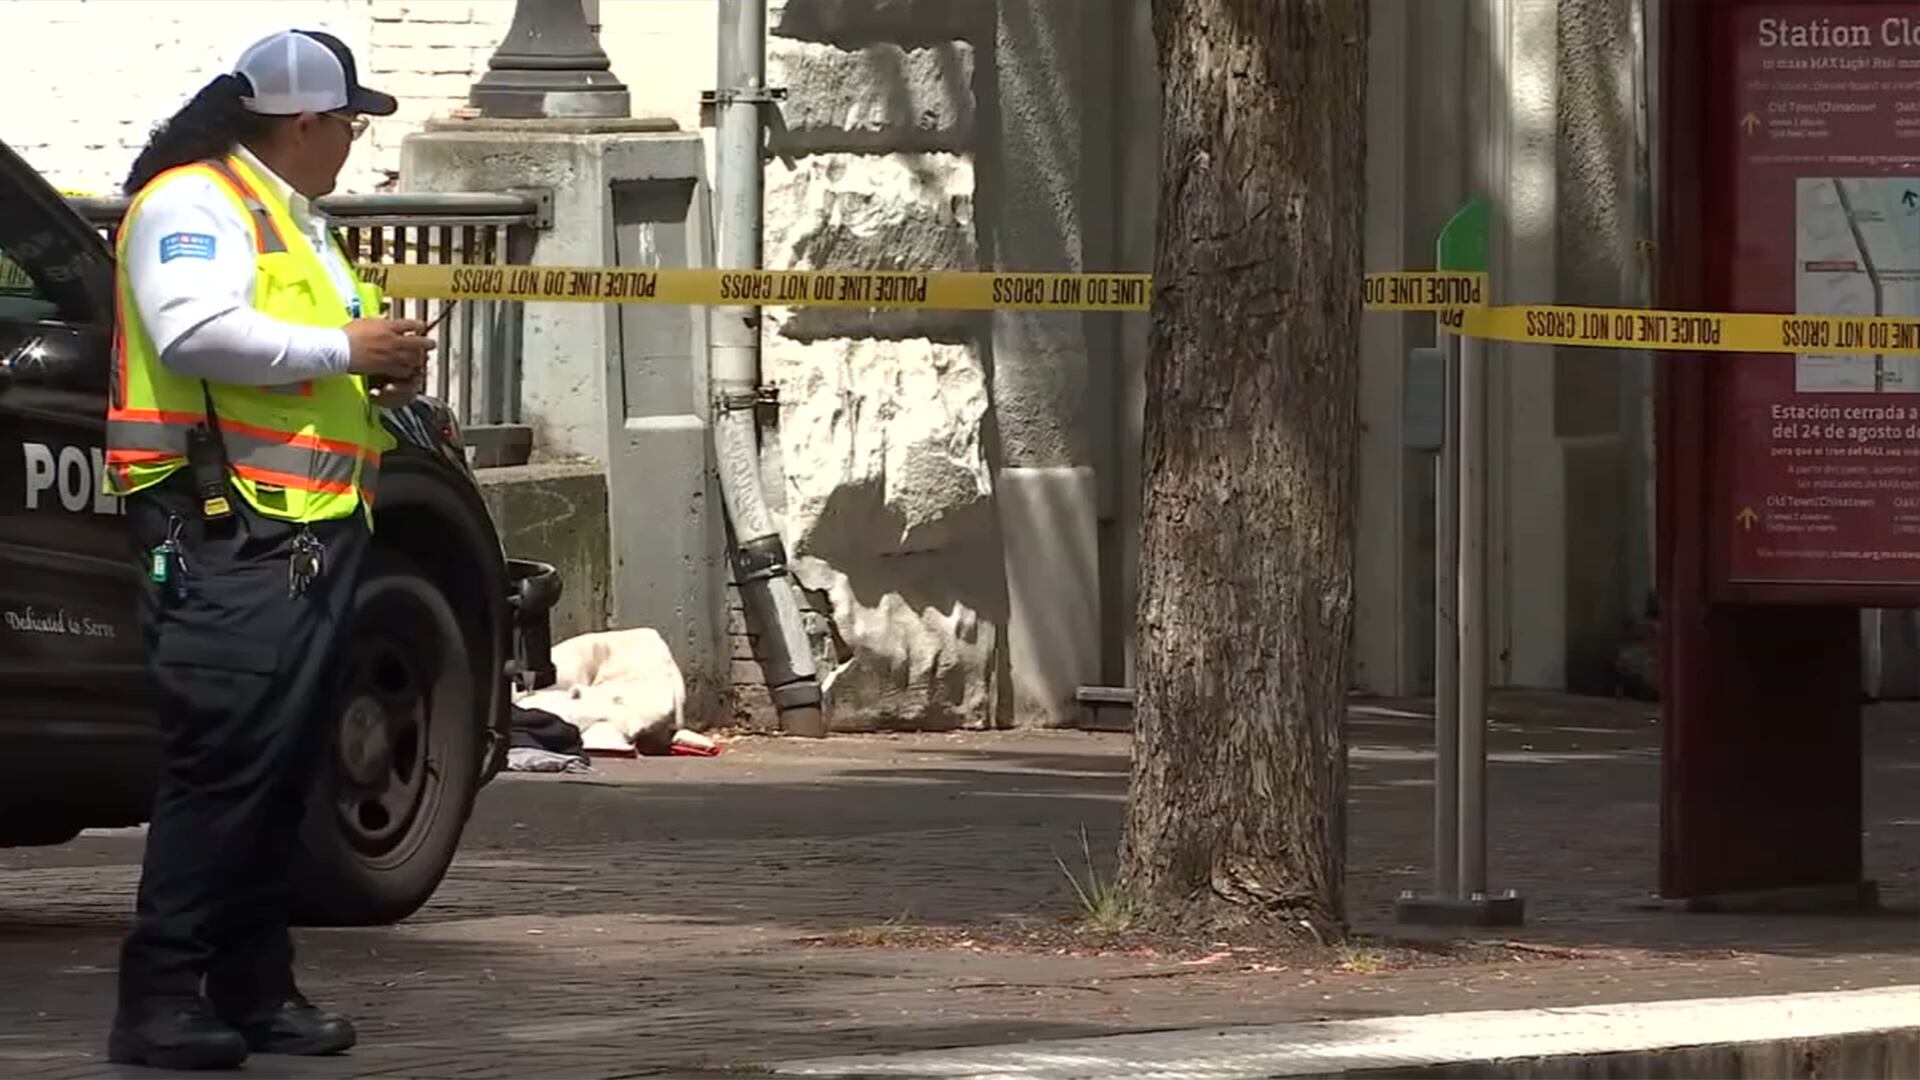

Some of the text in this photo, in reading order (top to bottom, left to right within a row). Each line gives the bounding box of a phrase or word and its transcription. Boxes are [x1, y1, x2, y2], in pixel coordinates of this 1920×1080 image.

[1759, 18, 1872, 47] Station
[451, 269, 657, 297] POLICE LINE DO NOT CROSS
[721, 275, 927, 301] POLICE LINE DO NOT CROSS
[993, 278, 1144, 304] LINE DO NOT CROSS
[1365, 277, 1480, 304] POLICE LINE DO
[1527, 310, 1720, 344] POLICE LINE DO NOT CROSS
[1783, 321, 1920, 348] LINE DO NOT CROSS
[1844, 404, 1905, 419] cerrada
[1909, 407, 1918, 419] a
[1773, 422, 1798, 439] del
[1802, 424, 1820, 438] 24
[1824, 423, 1845, 439] de
[1848, 425, 1901, 443] agosto
[22, 442, 127, 516] POL
[4, 606, 66, 633] Dedicated
